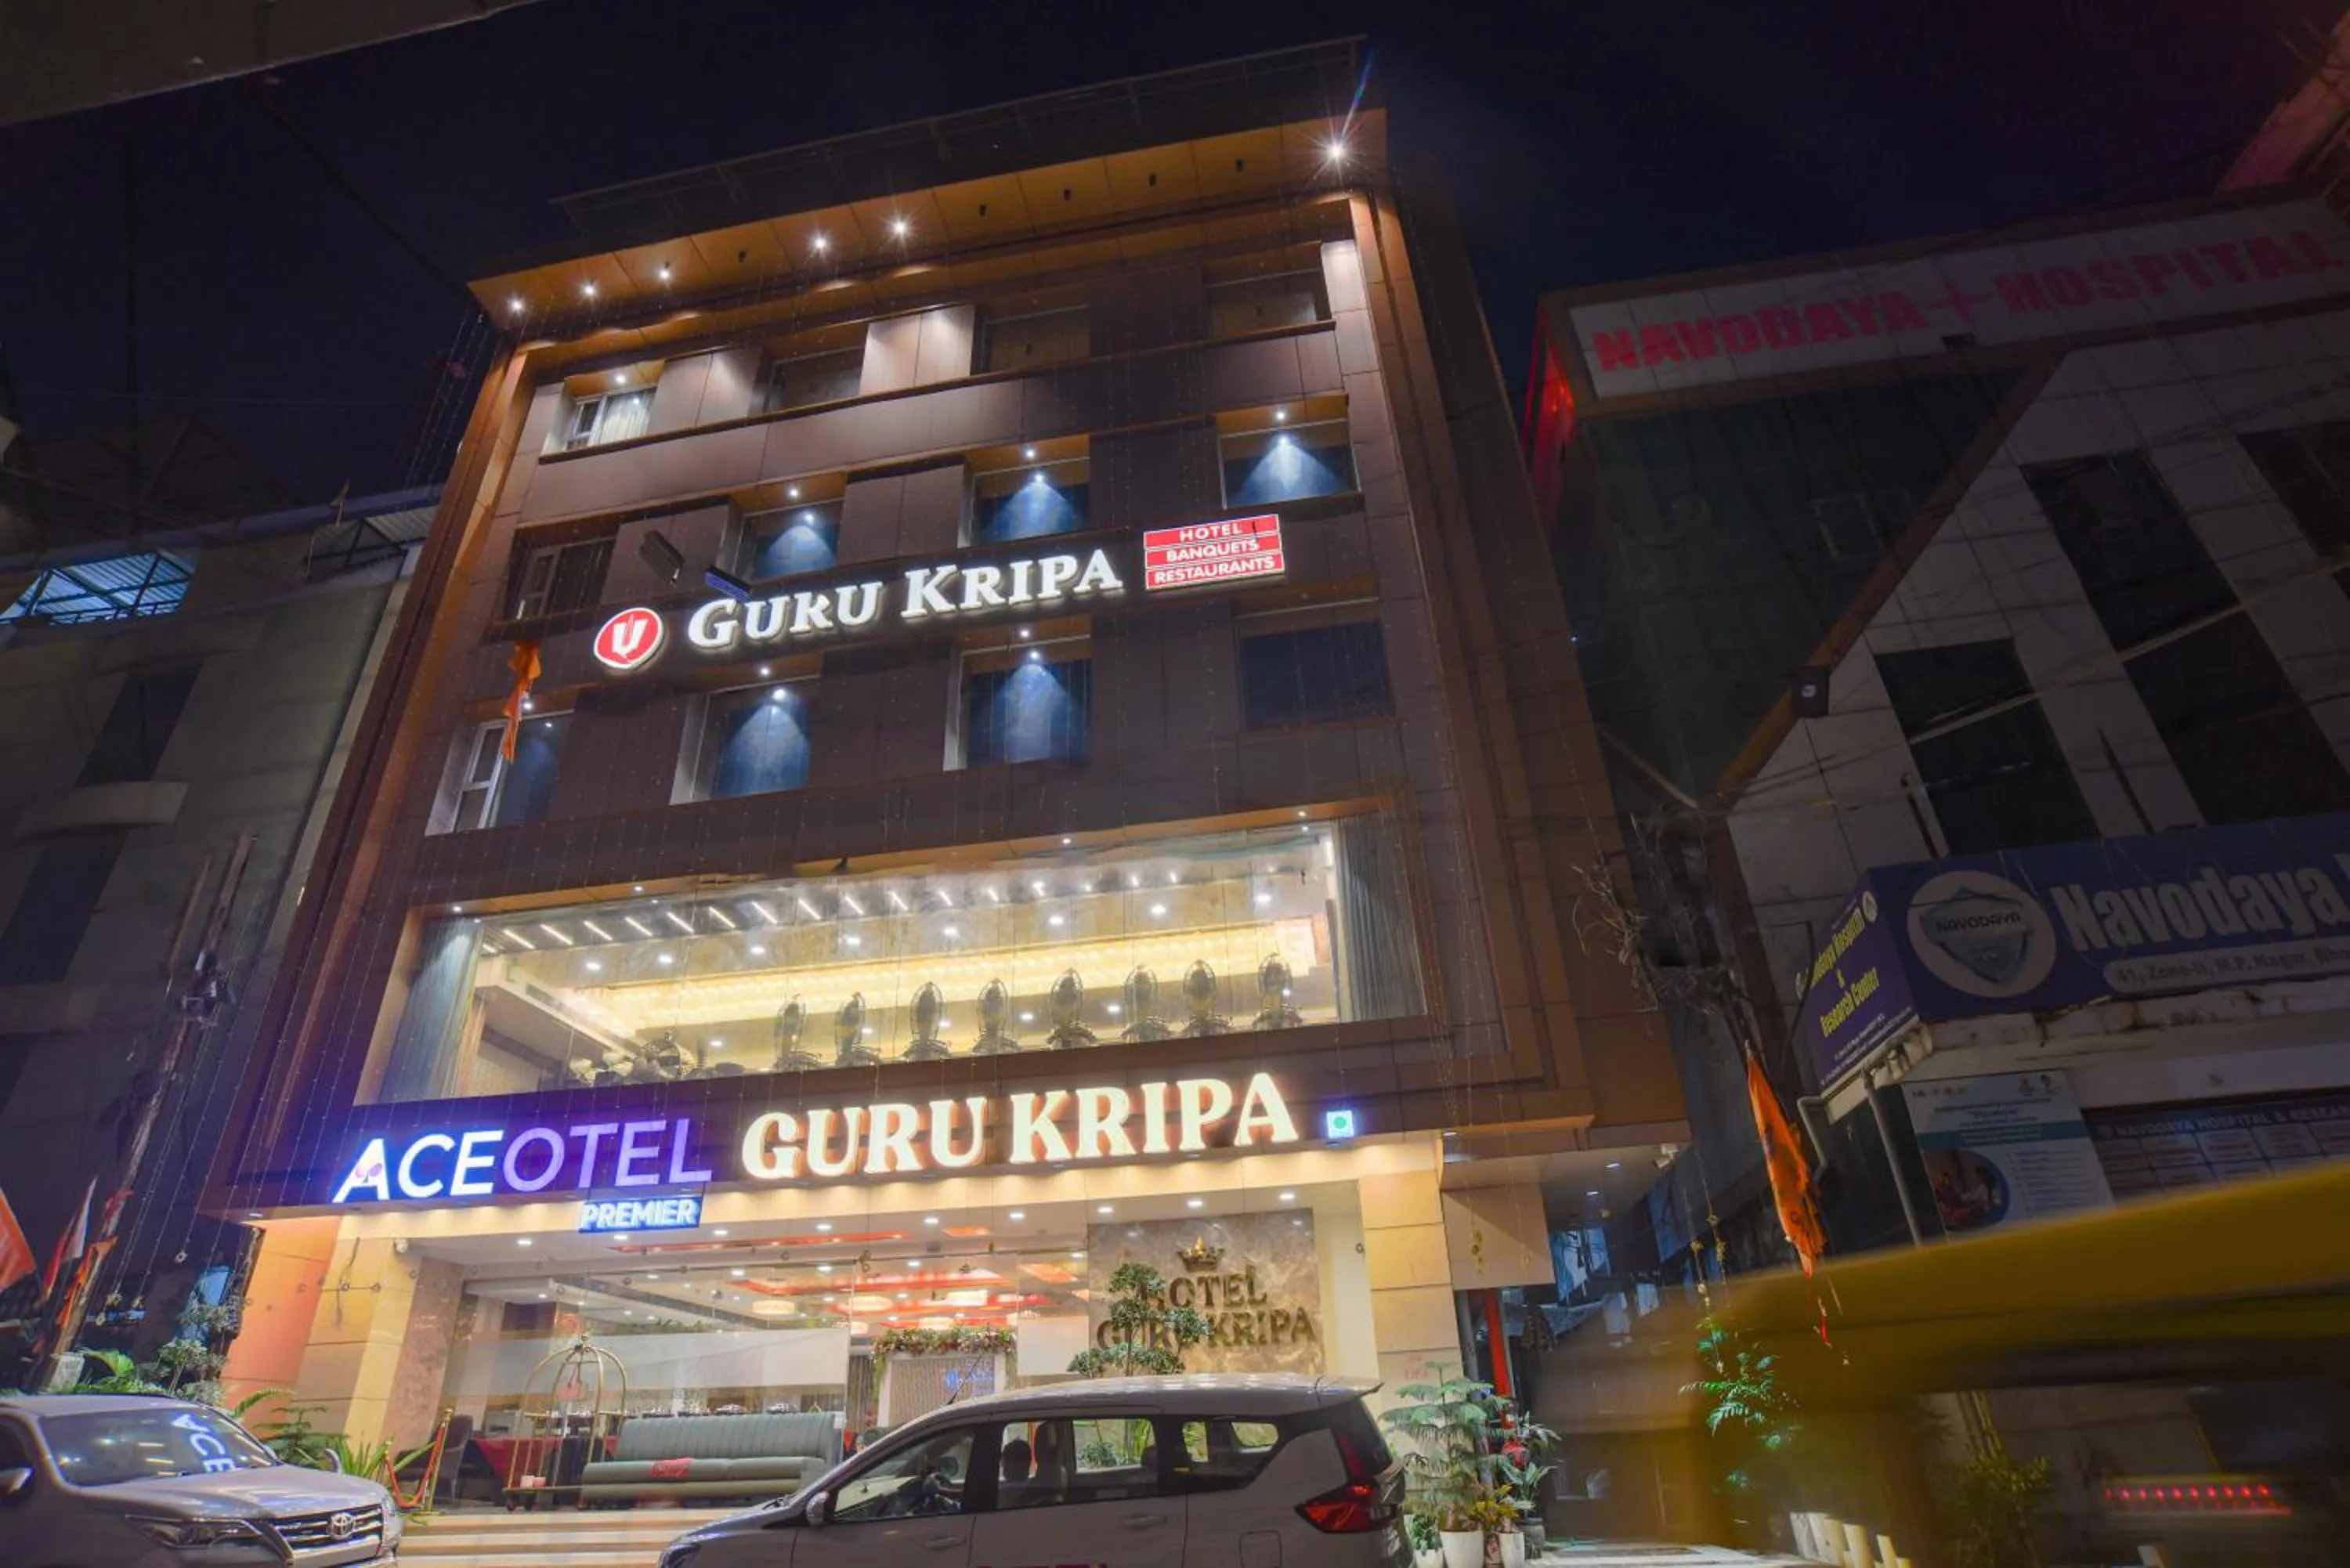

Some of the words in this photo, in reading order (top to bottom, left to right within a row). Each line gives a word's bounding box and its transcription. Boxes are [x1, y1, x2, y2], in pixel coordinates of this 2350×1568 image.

[1593, 291, 1929, 372] NAVODAYA
[1994, 230, 2343, 314] HOSPITAL
[1166, 539, 1260, 562] BANQUETS
[1179, 522, 1243, 542] HOTEL
[1154, 556, 1275, 583] RESTAURANTS
[687, 580, 883, 649] GURU
[900, 548, 1123, 618] KRIPA
[1934, 911, 2022, 934] NAVODAYA
[2048, 866, 2350, 952] Navodaya
[742, 1095, 988, 1180] GURU
[1009, 1071, 1299, 1164] KRIPA
[332, 1118, 712, 1204] ACEOTEL
[580, 1199, 698, 1230] PREMIER
[1206, 1306, 1317, 1347] KRIPA
